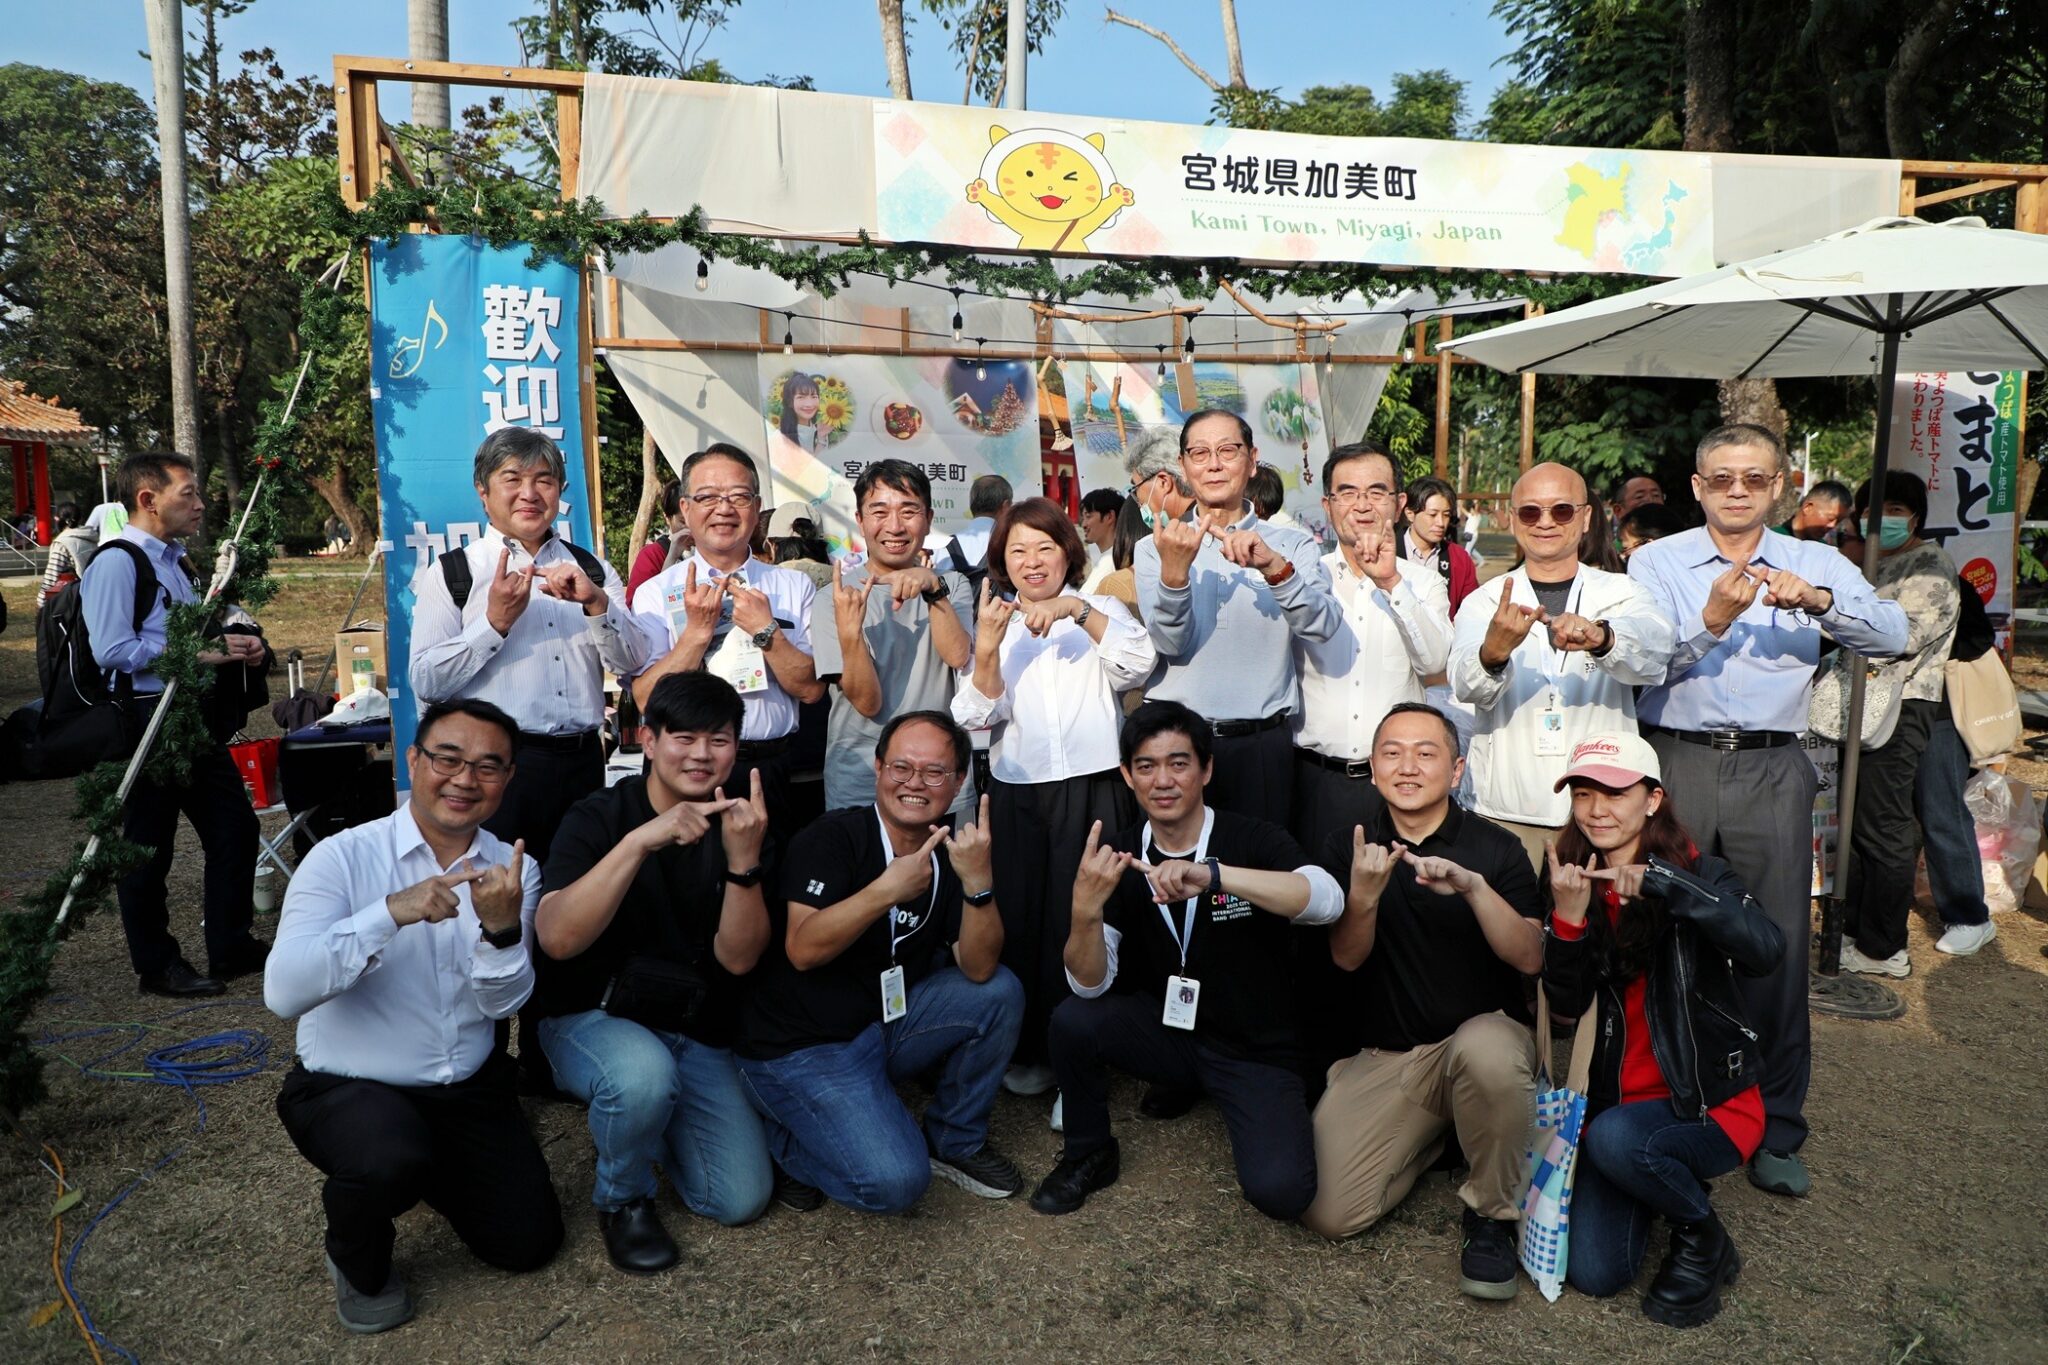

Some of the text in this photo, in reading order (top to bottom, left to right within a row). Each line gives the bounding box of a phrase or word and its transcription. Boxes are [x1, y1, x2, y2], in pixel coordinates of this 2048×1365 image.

[1182, 152, 1418, 201] 宮城県加美町
[1191, 210, 1503, 242] Kami Town, Miyagi, Japan
[1953, 371, 2000, 530] まと
[843, 460, 968, 482] 宮美町
